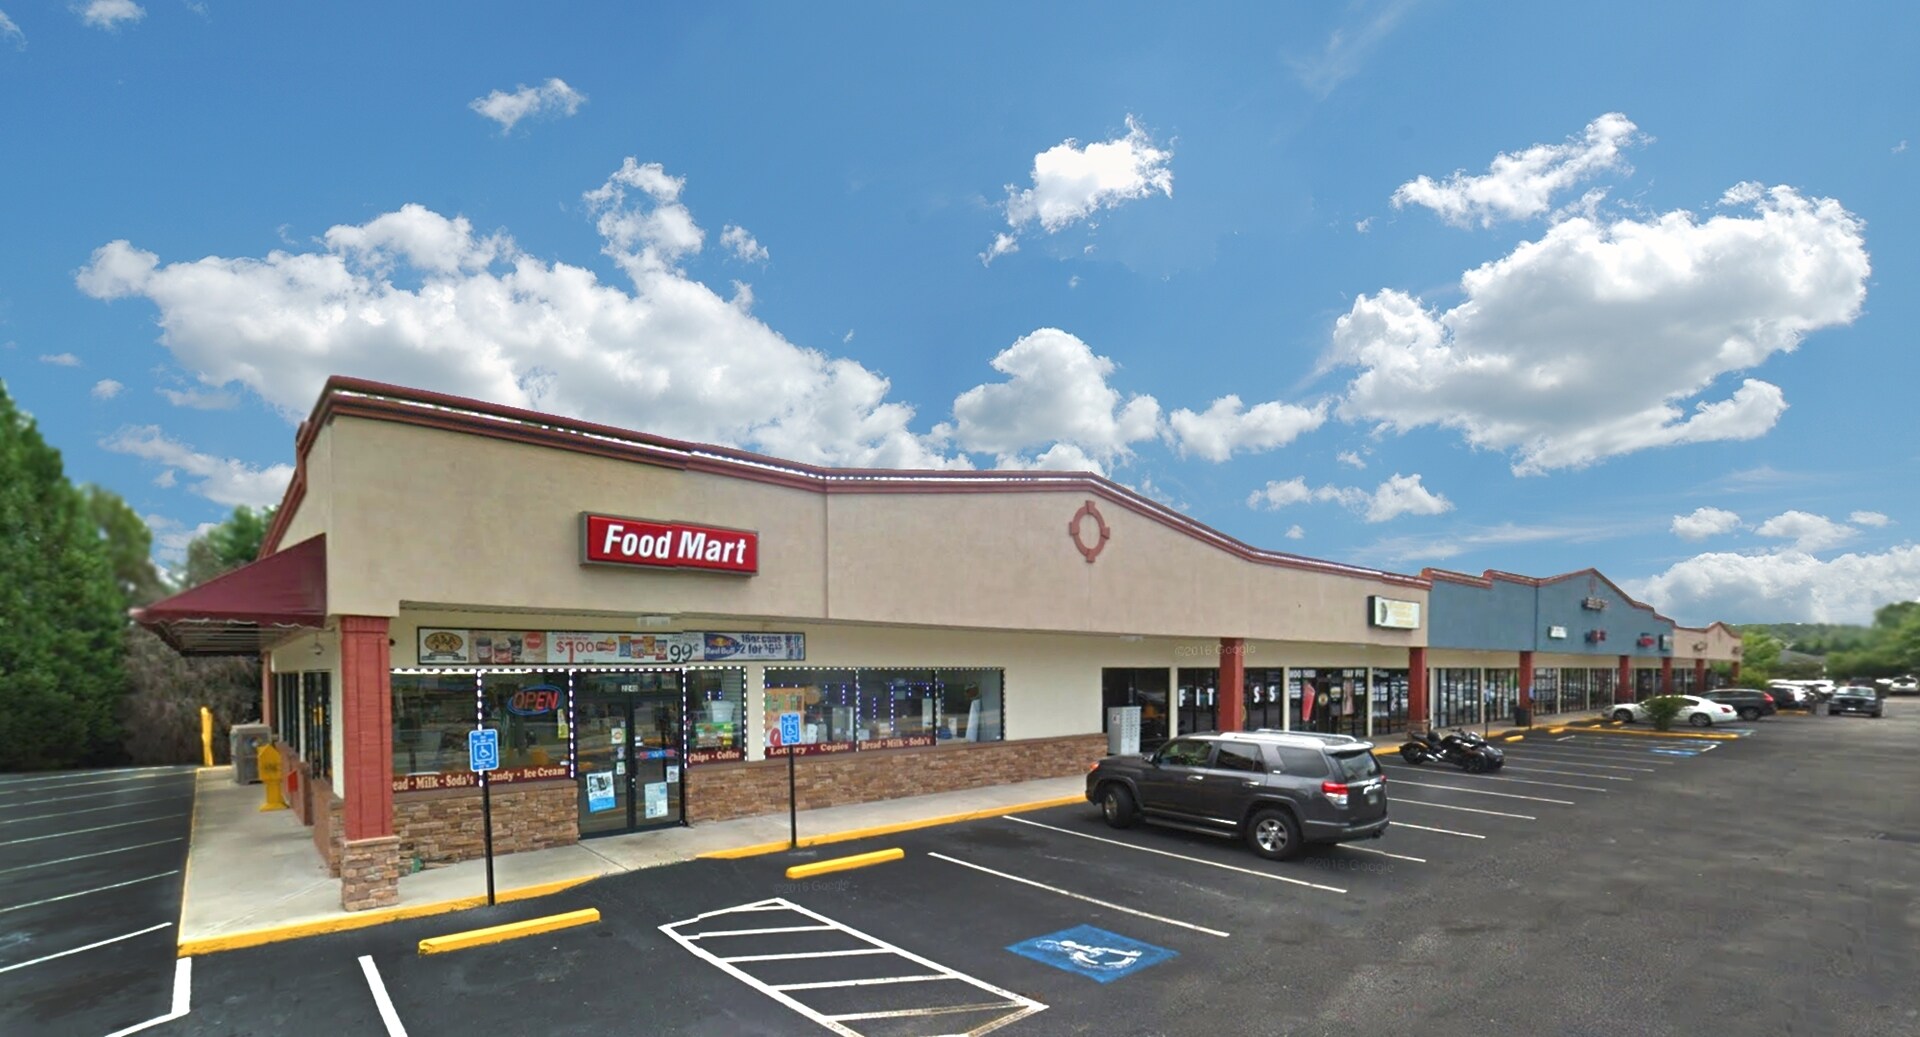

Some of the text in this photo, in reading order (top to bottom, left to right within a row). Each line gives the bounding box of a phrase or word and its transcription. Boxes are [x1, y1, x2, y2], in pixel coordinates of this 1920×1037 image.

[603, 524, 747, 564] Food Mart
[513, 690, 559, 711] OPEN
[1178, 685, 1276, 707] FITSS
[820, 743, 849, 752] Copies
[861, 741, 881, 750] Bread
[887, 739, 904, 748] Milk
[688, 751, 740, 763] Chips Coffee
[392, 778, 409, 791] ead
[415, 776, 439, 790] Milk
[446, 774, 474, 787] Soda's
[523, 769, 537, 778] Ice
[538, 767, 566, 777] Cream
